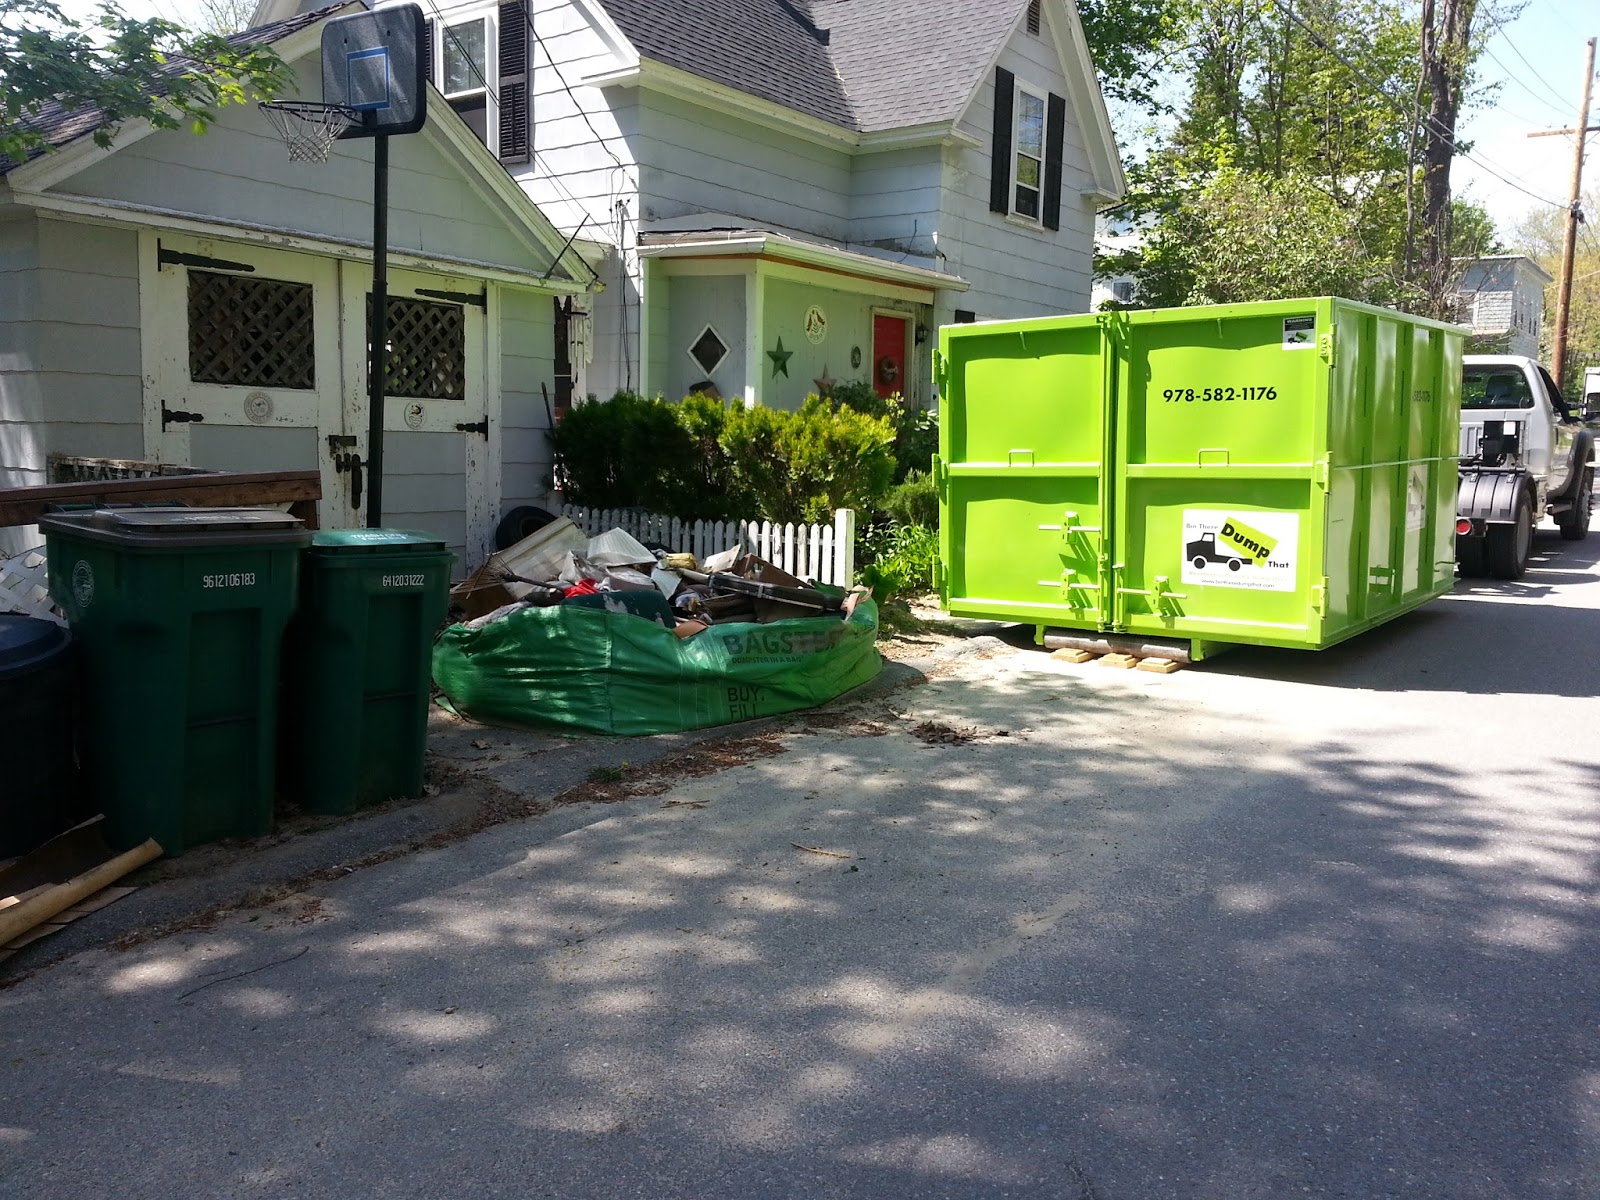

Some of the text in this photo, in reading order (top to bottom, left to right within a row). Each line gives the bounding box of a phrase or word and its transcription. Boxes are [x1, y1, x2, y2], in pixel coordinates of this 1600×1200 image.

[1163, 387, 1277, 402] 978-582-1176
[1220, 522, 1270, 559] Dump
[203, 572, 256, 588] 9612106183
[382, 574, 425, 587] 6412031222
